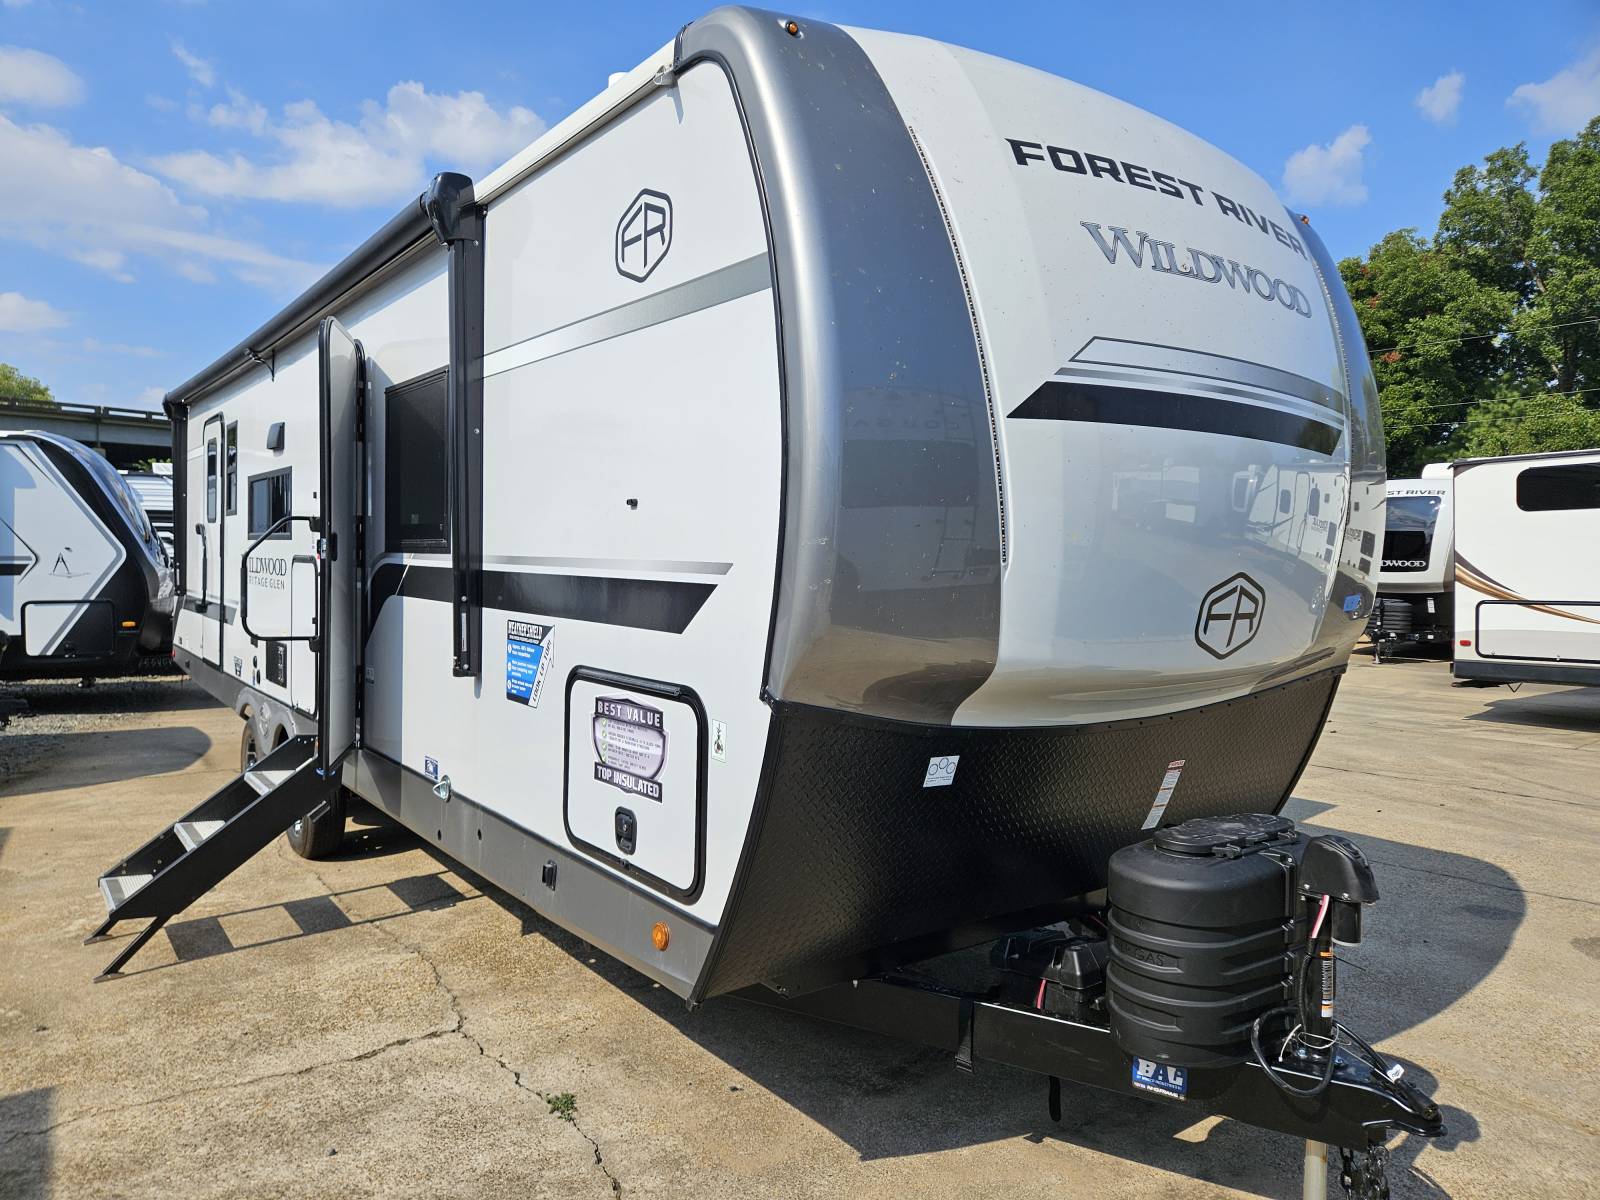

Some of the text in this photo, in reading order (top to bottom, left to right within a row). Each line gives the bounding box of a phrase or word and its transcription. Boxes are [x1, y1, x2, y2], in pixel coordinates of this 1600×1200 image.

[1004, 137, 1308, 261] FOREST RIVER
[1079, 220, 1312, 319] WILDWOOD
[248, 557, 287, 576] ILDWOOD
[1381, 559, 1427, 567] DWOOD
[269, 578, 285, 590] GLEN
[597, 700, 622, 717] BEST
[627, 704, 661, 727] VALUE
[597, 765, 660, 798] TOP INSULATED
